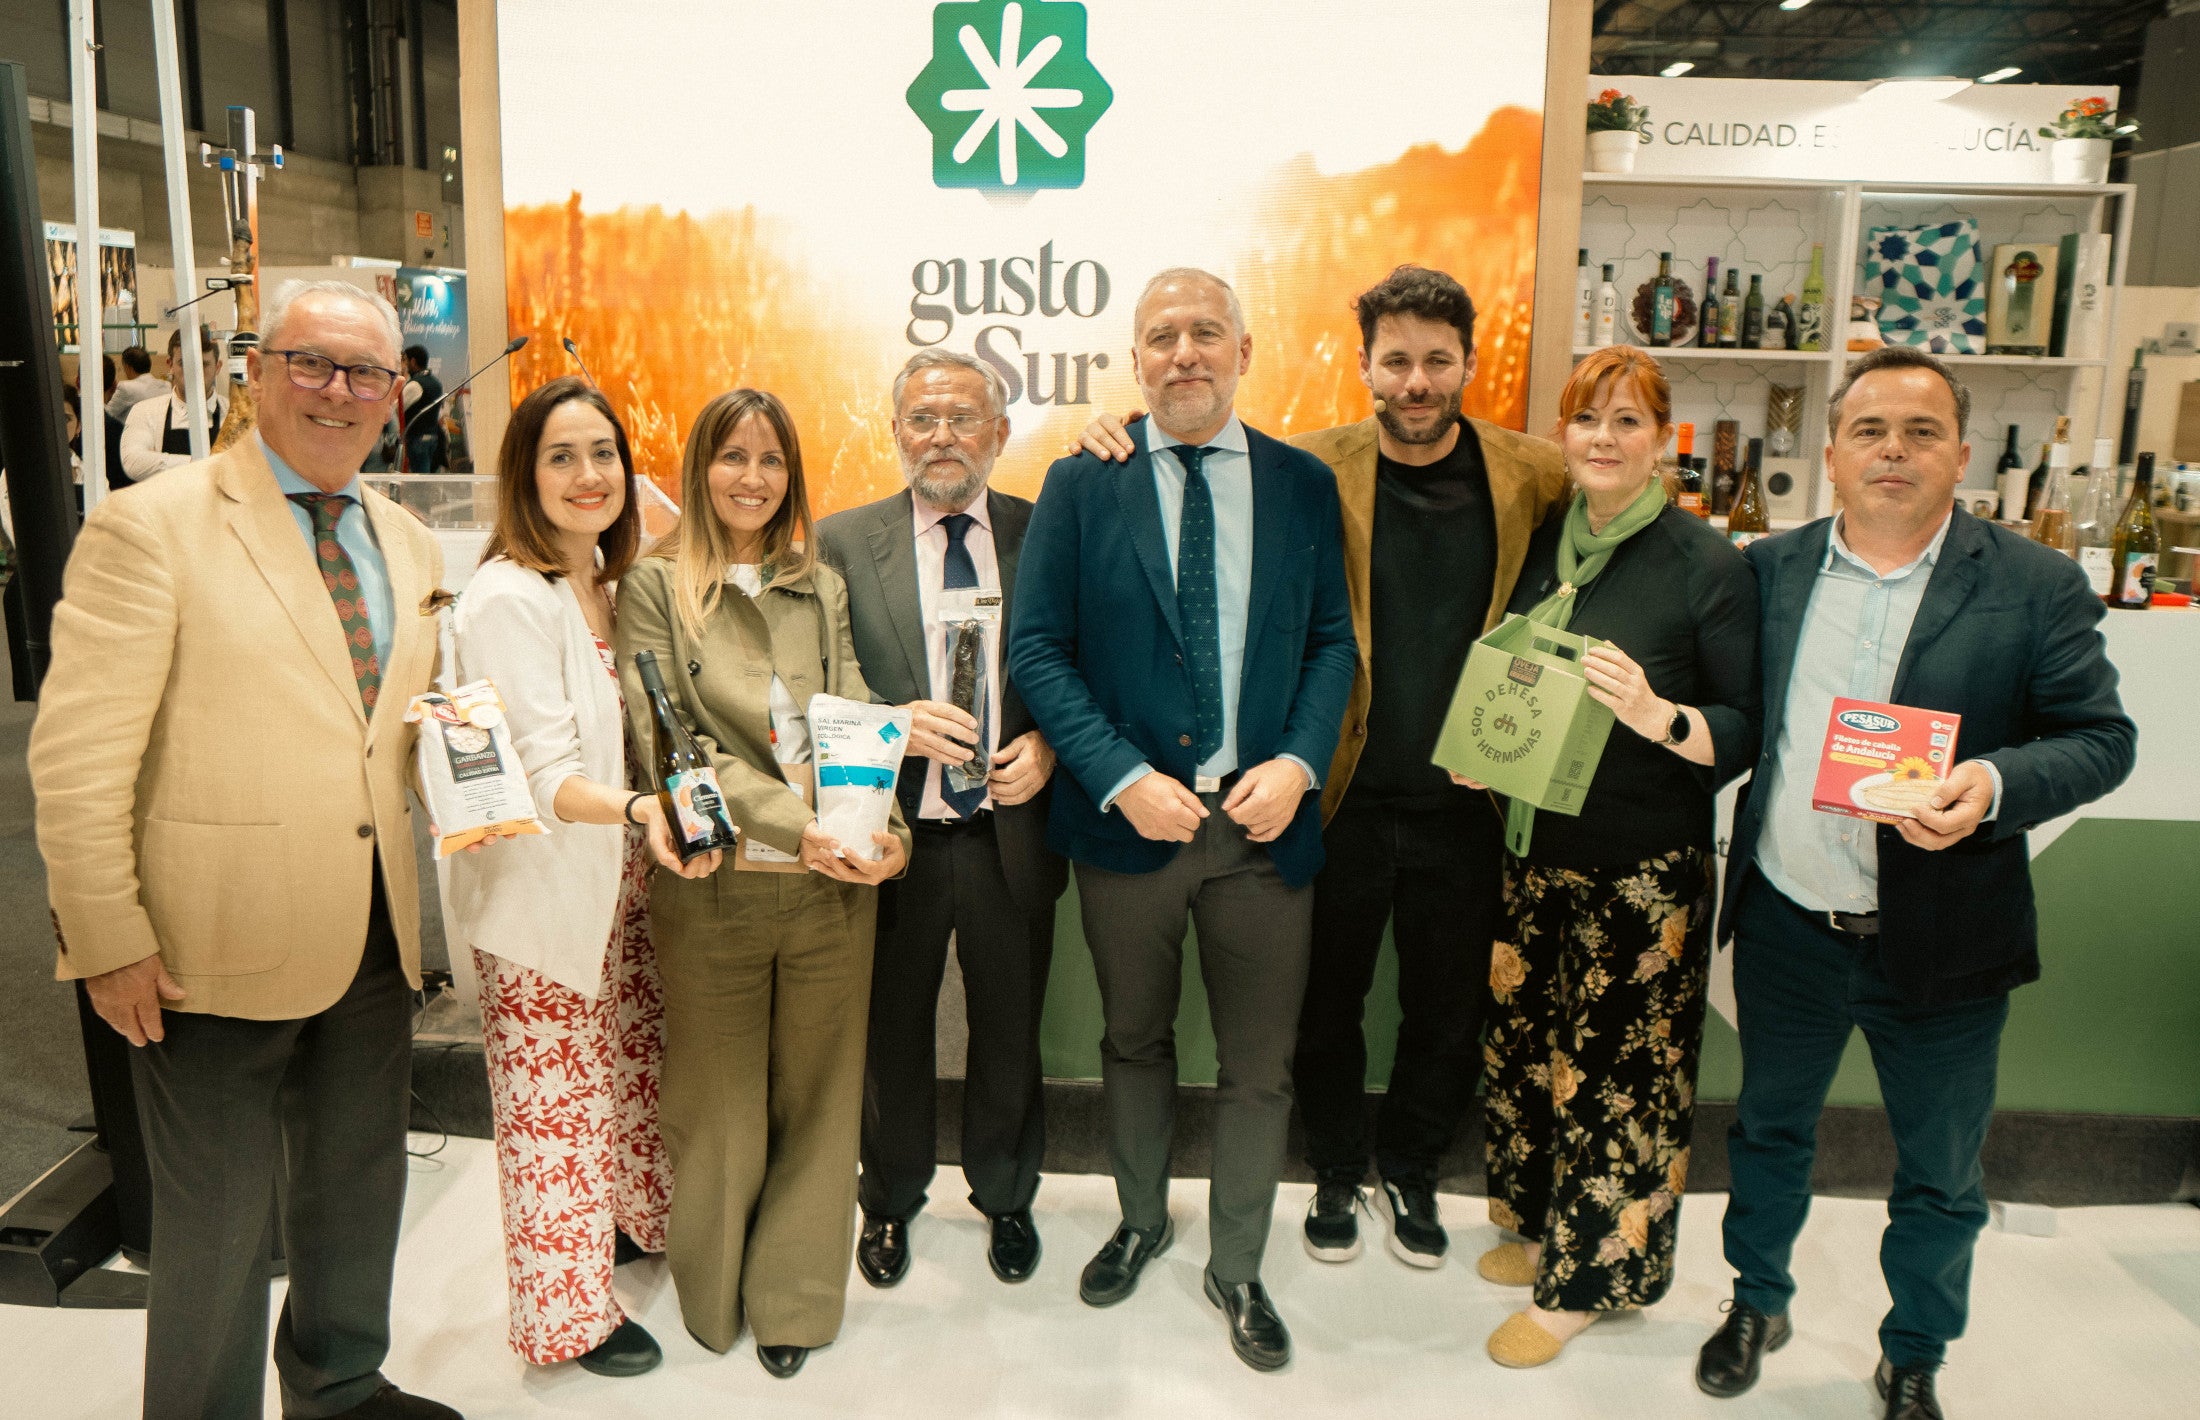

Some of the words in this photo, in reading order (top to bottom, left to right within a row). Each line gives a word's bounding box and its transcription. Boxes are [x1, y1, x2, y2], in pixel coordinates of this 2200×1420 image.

[1639, 121, 1655, 145] S
[1664, 121, 1802, 148] CALIDAD.
[1813, 125, 1842, 149] E
[906, 239, 1112, 346] gusto
[975, 325, 1111, 406] Sur
[1485, 682, 1543, 720] DEHESA
[832, 719, 862, 727] MARINA
[1471, 706, 1486, 738] DOS
[1843, 713, 1896, 731] PESASUR
[455, 751, 496, 764] GARBANZO
[1476, 727, 1543, 764] HERMANAS
[1831, 742, 1845, 752] de
[1845, 744, 1896, 761] Andalucía
[1860, 738, 1872, 747] de
[1872, 741, 1902, 752] caballa
